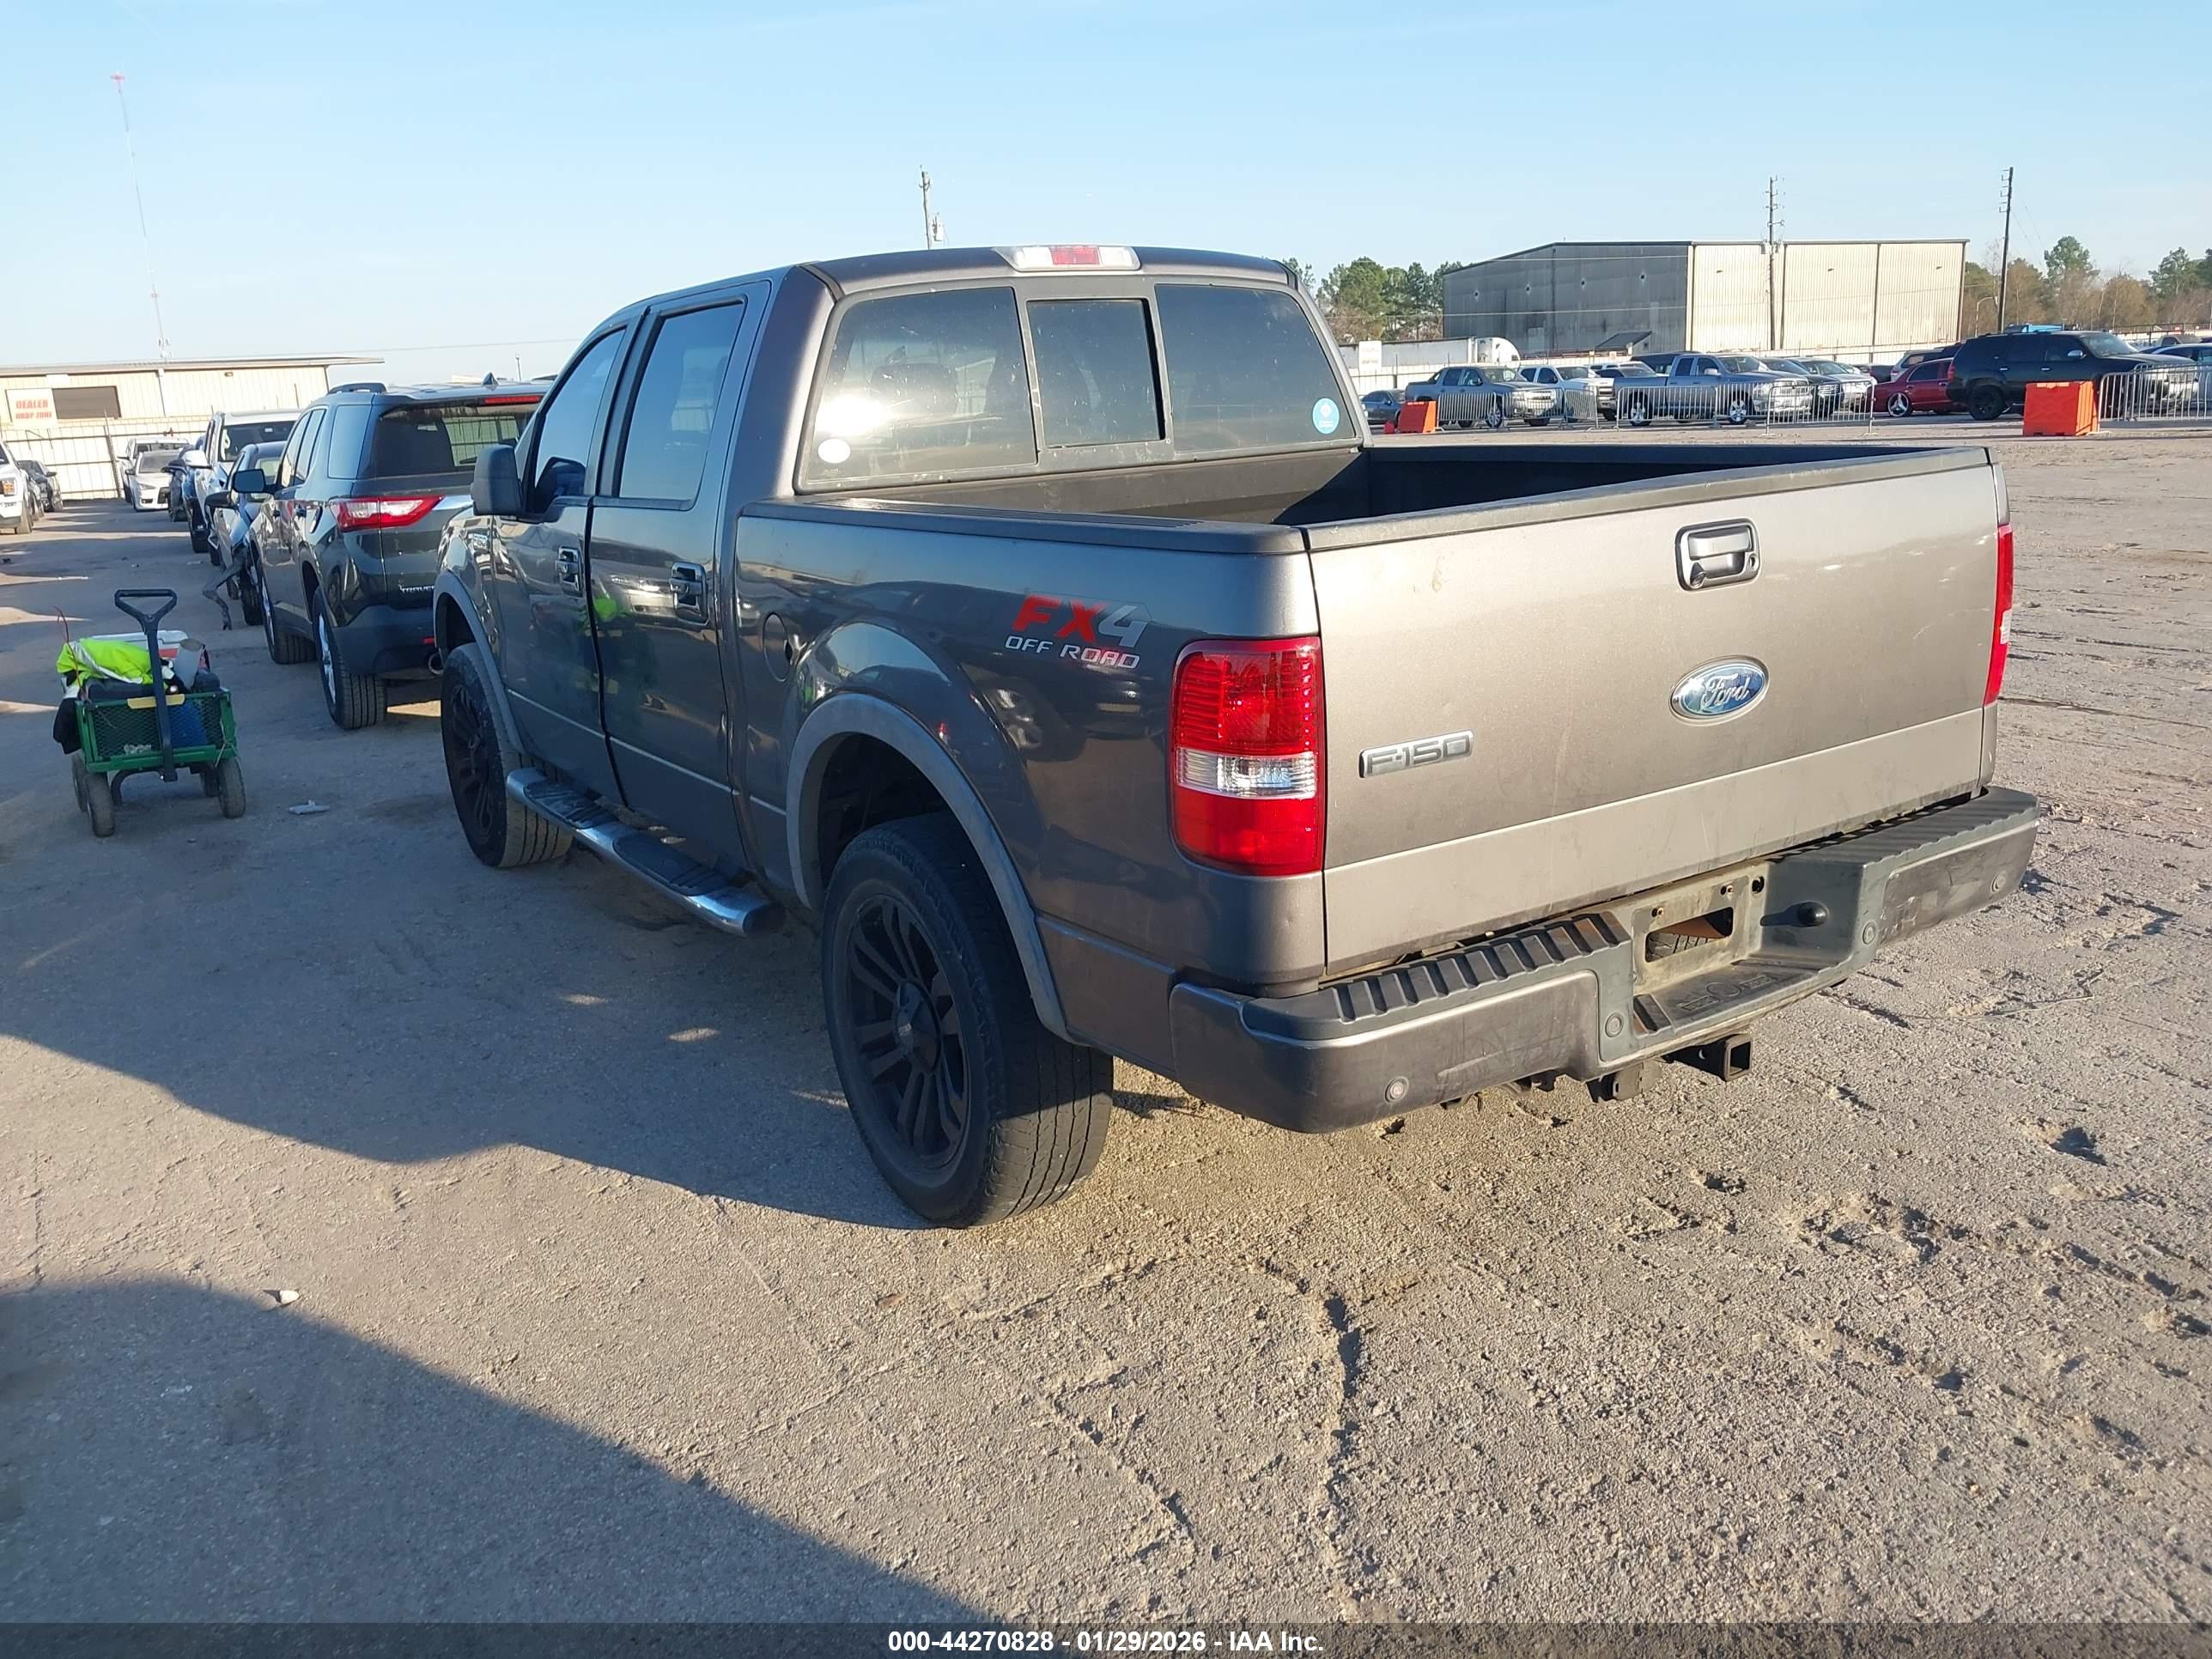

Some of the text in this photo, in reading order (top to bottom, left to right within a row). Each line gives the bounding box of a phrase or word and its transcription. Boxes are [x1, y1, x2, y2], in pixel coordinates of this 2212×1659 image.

[16, 399, 48, 409] DEALER
[1012, 593, 1148, 648] FX4
[1005, 635, 1141, 670] OFF ROAD
[1700, 672, 1751, 712] Ford
